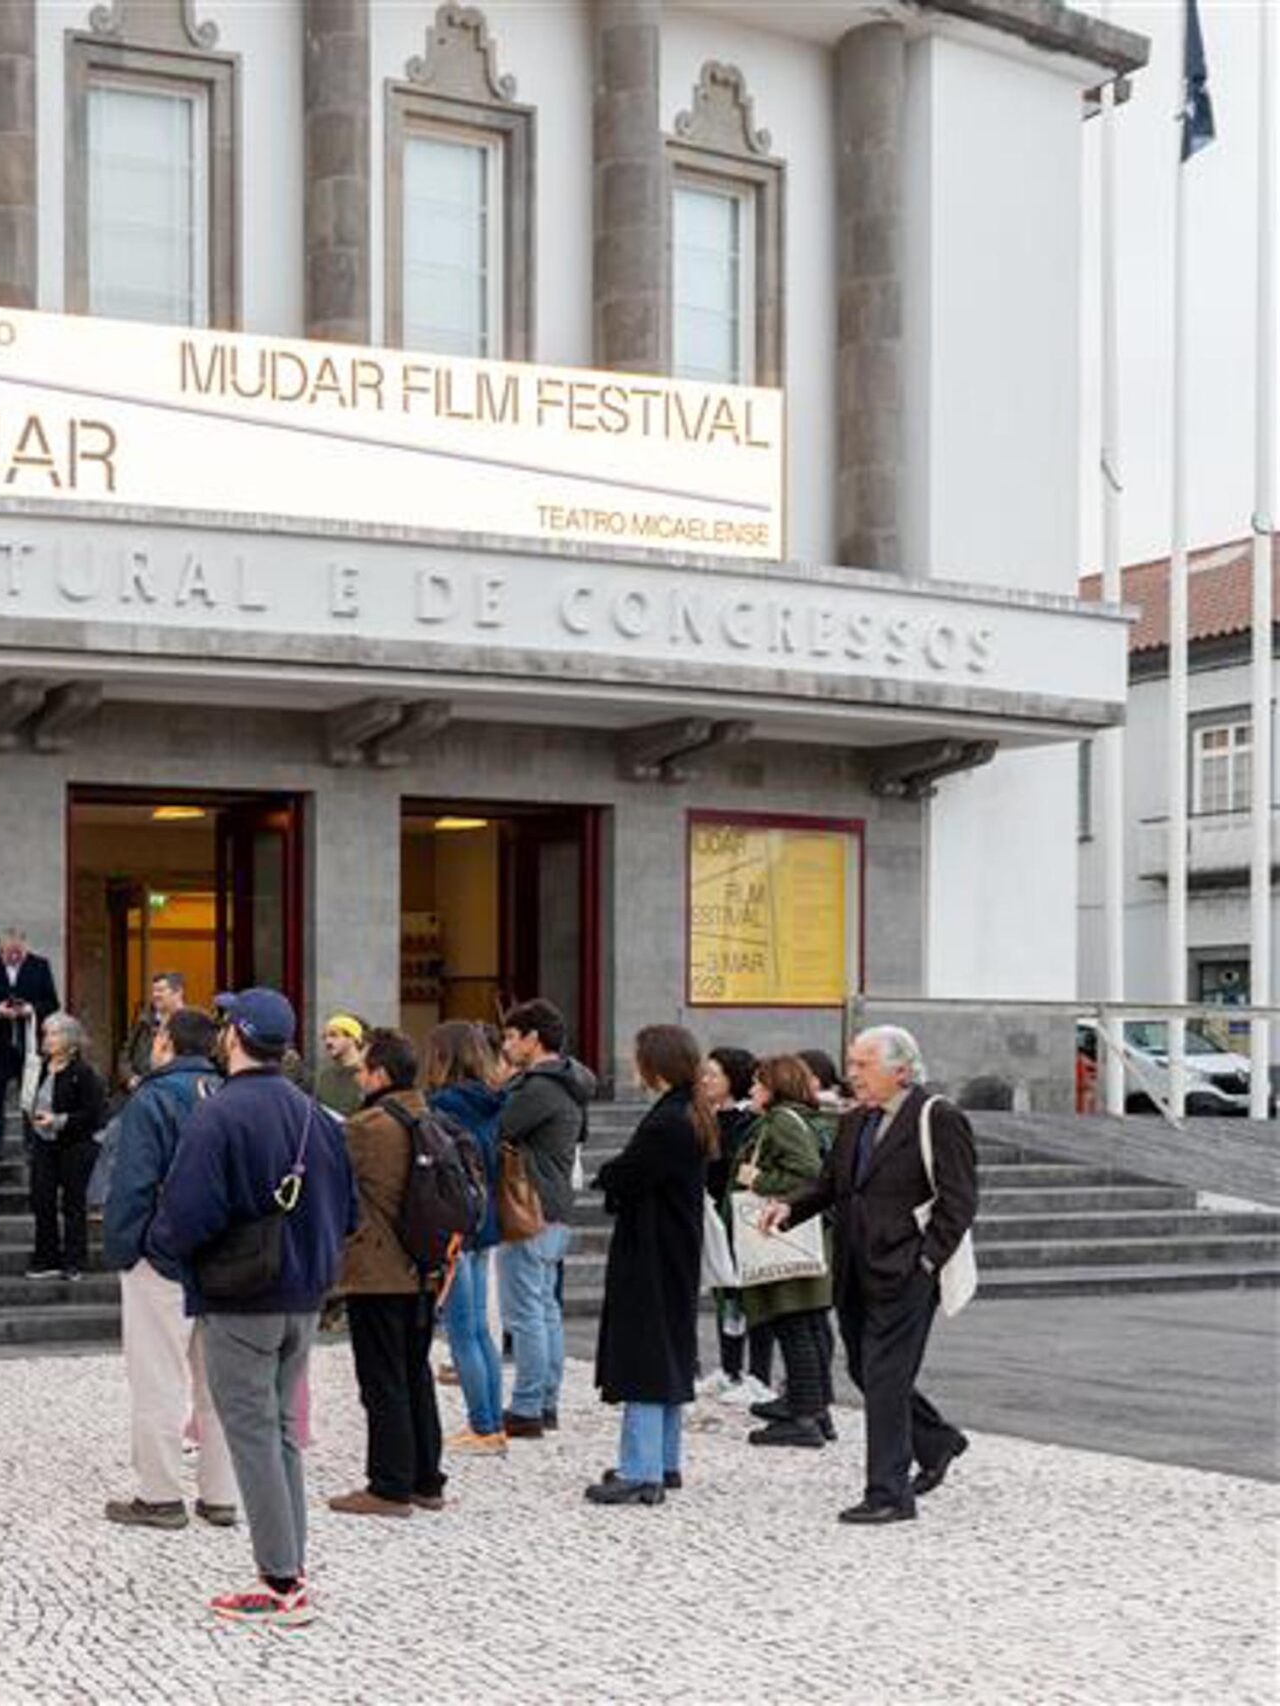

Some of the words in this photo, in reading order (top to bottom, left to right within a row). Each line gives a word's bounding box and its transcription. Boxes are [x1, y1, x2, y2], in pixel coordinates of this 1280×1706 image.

[178, 341, 385, 412] MUDAR
[402, 365, 520, 425] FILM
[537, 378, 771, 450] FESTIVAL
[537, 504, 628, 535] TEATRO
[631, 512, 771, 548] MICAELENSE
[326, 561, 361, 620] E
[414, 568, 505, 630] DE
[556, 583, 999, 676] CONGRESSOS
